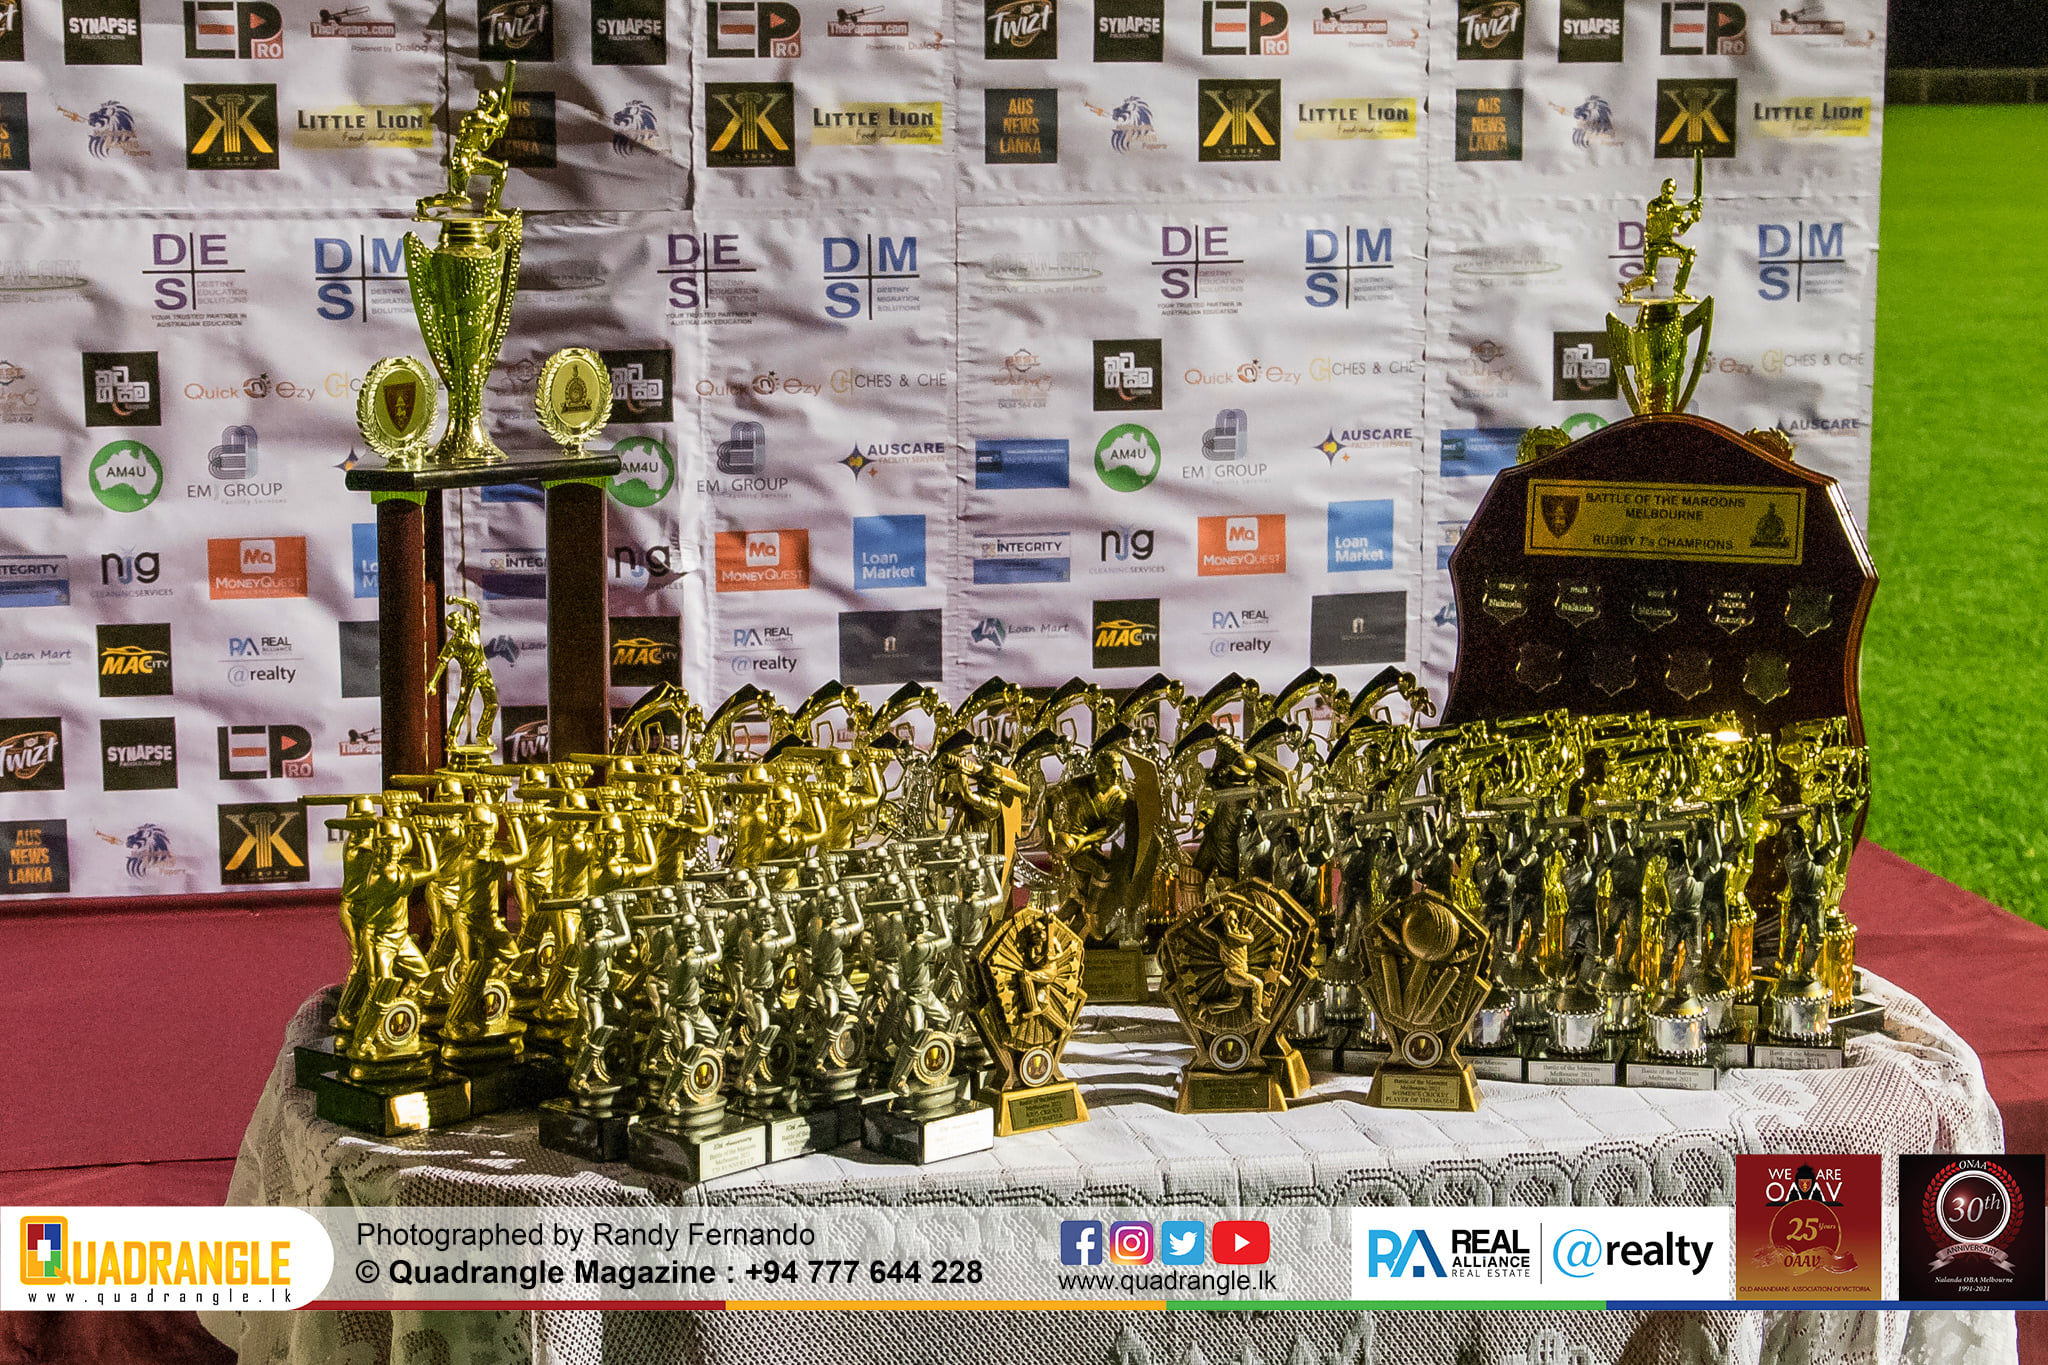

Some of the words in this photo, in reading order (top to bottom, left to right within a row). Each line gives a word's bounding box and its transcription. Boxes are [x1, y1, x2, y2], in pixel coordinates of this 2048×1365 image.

[69, 16, 137, 36] SYNAPSE
[598, 17, 661, 36] SYNAPSE
[828, 22, 908, 37] ThePapare.com
[1100, 15, 1160, 34] SYNAPSE
[1563, 17, 1619, 36] SYNAPSE
[1266, 39, 1288, 54] RO
[1008, 98, 1033, 115] AUS
[1298, 103, 1357, 121] LITTLE
[1477, 98, 1500, 113] AUS
[1755, 103, 1816, 120] LITTLE
[299, 110, 366, 130] LITTLE
[814, 108, 877, 127] LITTLE
[1472, 117, 1506, 133] NEWS
[1003, 117, 1040, 134] NEWS
[1000, 138, 1041, 154] LANKA
[1332, 361, 1365, 376] CHES
[1373, 361, 1381, 374] &
[855, 374, 892, 388] CHES
[900, 374, 909, 387] &
[1185, 369, 1233, 385] Quick
[185, 383, 238, 400] Quick
[1790, 418, 1859, 431] AUSCARE
[1341, 428, 1412, 441] AUSCARE
[868, 443, 945, 457] AUSCARE
[1111, 448, 1146, 460] AM4U
[106, 465, 146, 478] AM4U
[621, 460, 659, 474] AM4U
[1183, 465, 1204, 479] EM
[1215, 463, 1267, 478] GROUP
[187, 483, 212, 498] EM
[224, 483, 282, 498] GROUP
[697, 479, 720, 493] EM
[732, 478, 788, 492] GROUP
[1585, 493, 1630, 504] BATTLE
[1632, 494, 1650, 504] OF
[1654, 495, 1678, 506] THE
[1682, 496, 1745, 508] MAROONS
[1626, 508, 1703, 520] MELBOURNE
[997, 540, 1062, 553] INTEGRITY
[1335, 536, 1368, 549] Loan
[1593, 535, 1636, 546] RUGBY
[1658, 537, 1733, 550] CHAMPIONS
[862, 552, 899, 565] Loan
[1335, 548, 1384, 563] Market
[862, 565, 916, 580] Market
[1488, 600, 1522, 609] Nalanda
[1561, 603, 1594, 613] Nalanda
[1241, 610, 1267, 621] REAL
[765, 627, 793, 638] REAL
[1007, 623, 1037, 634] Loan
[1041, 622, 1069, 634] Mart
[261, 636, 292, 647] REAL
[1096, 629, 1142, 647] MAC
[5, 651, 35, 661] Loan
[40, 649, 71, 660] Mart
[1210, 638, 1271, 657] @realty
[613, 648, 661, 665] MAC
[102, 656, 154, 675] MAC
[731, 655, 797, 674] @realty
[228, 665, 297, 687] @realty
[107, 745, 172, 763] SYNAPSE
[16, 829, 42, 846] AUS
[10, 848, 49, 865] NEWS
[9, 868, 53, 884] LANKA
